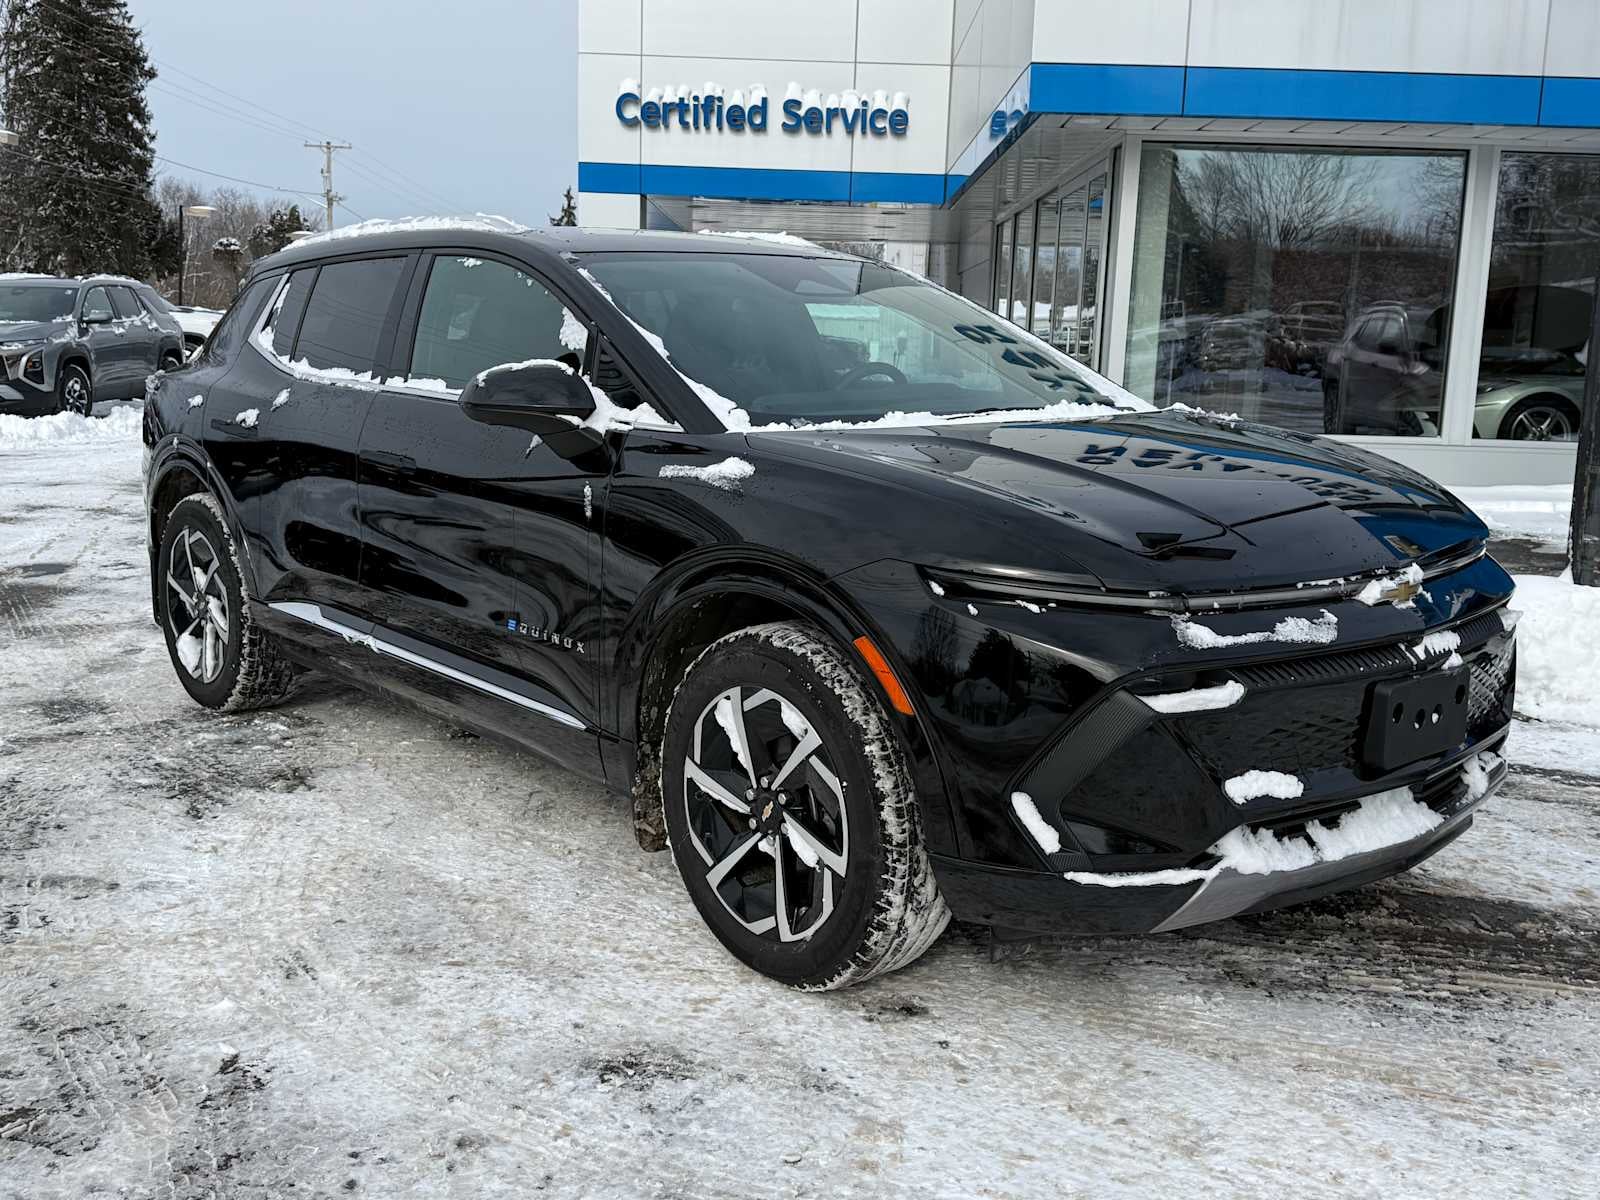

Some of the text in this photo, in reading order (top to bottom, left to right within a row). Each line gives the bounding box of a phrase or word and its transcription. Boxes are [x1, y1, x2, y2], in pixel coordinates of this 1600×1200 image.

[615, 92, 910, 136] Certified Service
[506, 618, 585, 654] EQUINOX
